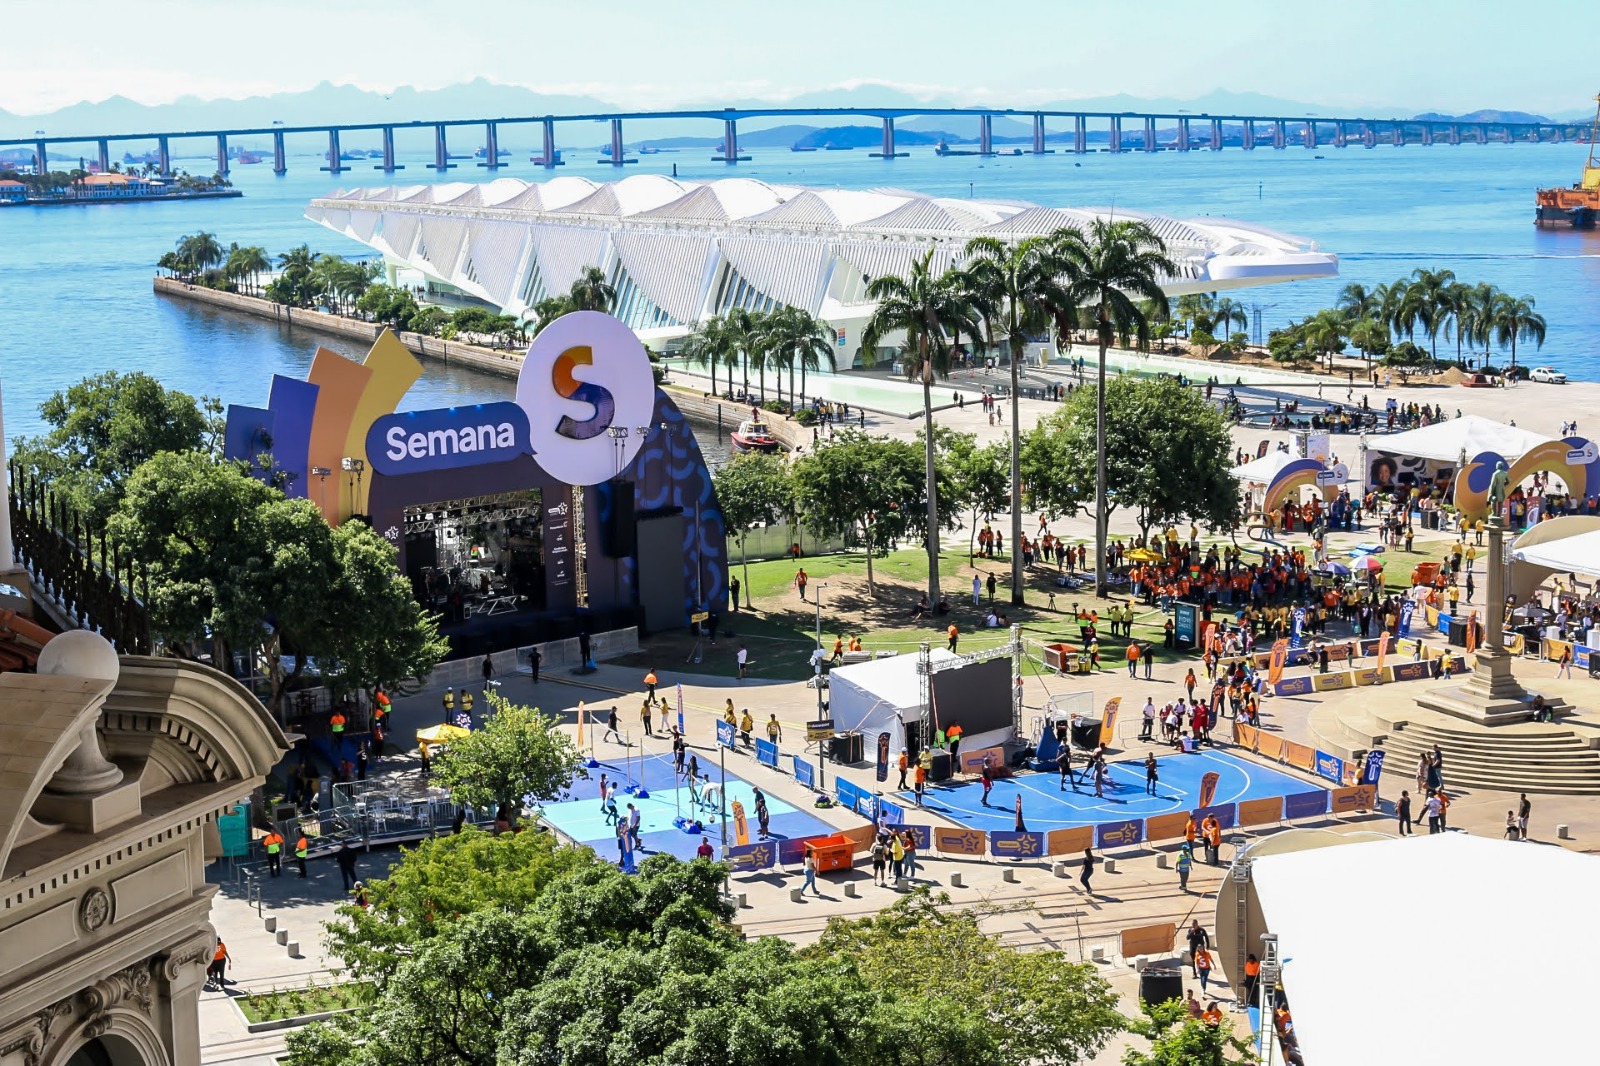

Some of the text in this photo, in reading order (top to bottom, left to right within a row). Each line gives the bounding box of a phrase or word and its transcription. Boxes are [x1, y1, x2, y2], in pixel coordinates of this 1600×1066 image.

[386, 345, 616, 461] Semana S
[1586, 448, 1593, 457] S
[1125, 829, 1131, 838] S
[966, 838, 973, 846] S
[1023, 841, 1030, 849] S
[757, 852, 763, 860] S
[1200, 959, 1206, 967] S
